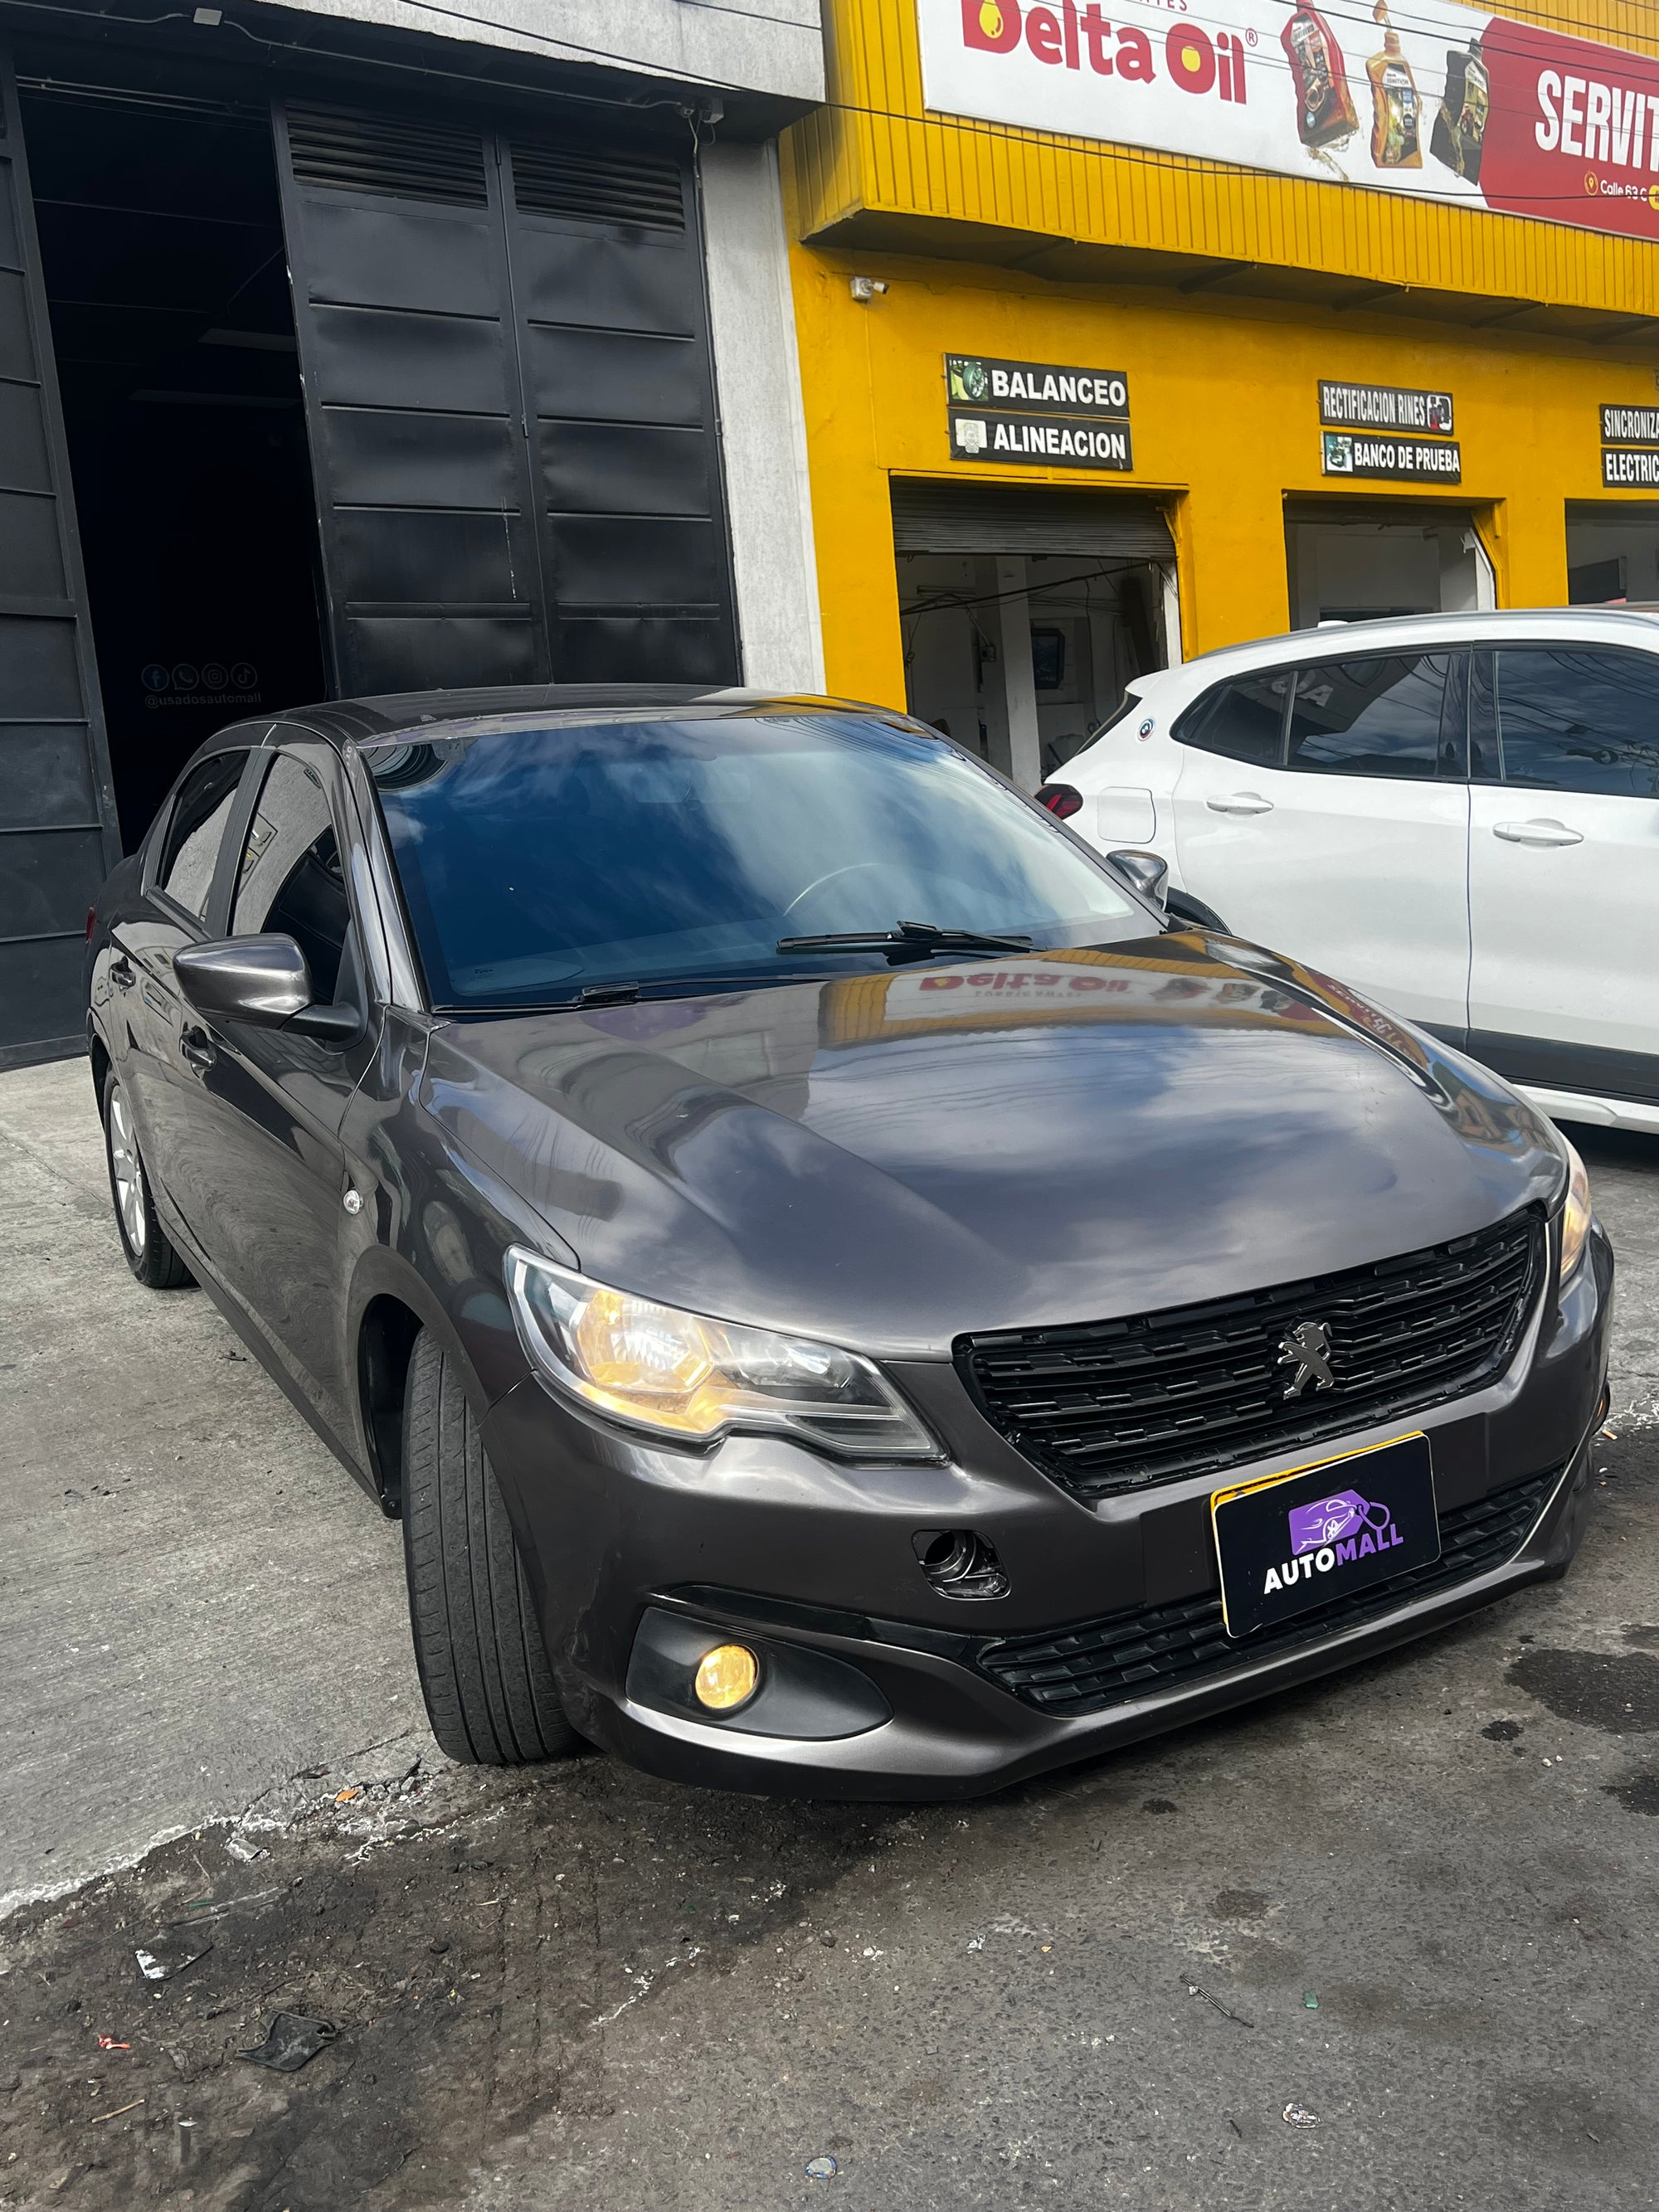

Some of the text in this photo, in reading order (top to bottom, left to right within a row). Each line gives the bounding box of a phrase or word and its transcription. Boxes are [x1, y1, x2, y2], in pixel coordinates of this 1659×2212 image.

[961, 0, 1156, 84] Delta
[1600, 179, 1623, 196] Calle
[991, 369, 1126, 406] BALANCEO
[1323, 386, 1425, 426] RECTIFICACION RINES
[994, 423, 1126, 459] ALINEACION
[1354, 442, 1461, 472] BANCO DE PRUEBA
[1605, 453, 1659, 483] ELECTRIC
[144, 692, 261, 709] @usadosautomall
[1263, 1523, 1404, 1595] AUTOMALL
